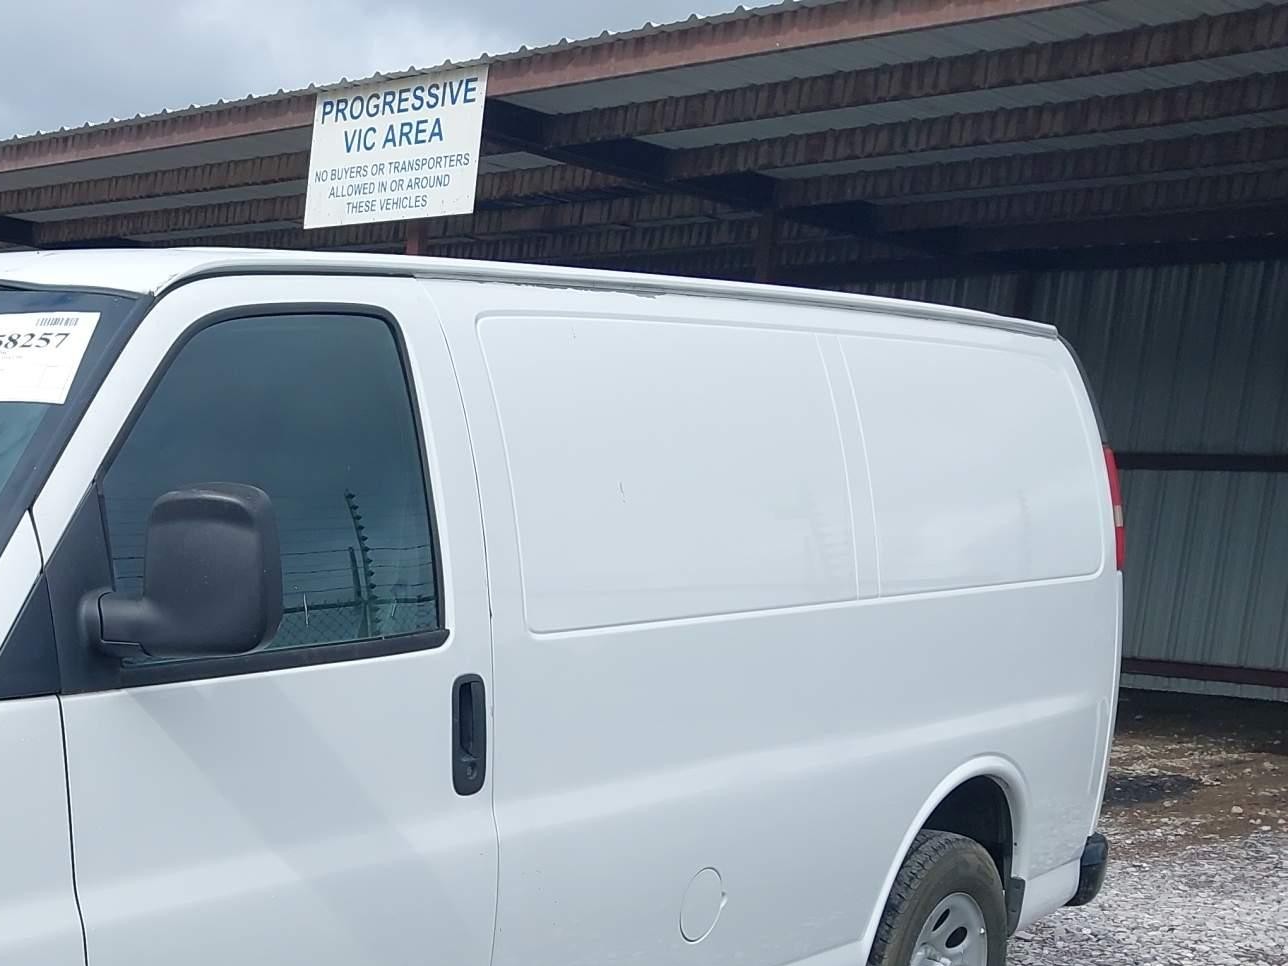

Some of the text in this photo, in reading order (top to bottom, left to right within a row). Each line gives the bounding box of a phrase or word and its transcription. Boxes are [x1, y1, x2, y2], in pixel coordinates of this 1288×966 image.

[321, 77, 479, 125] PROGRESSIVE
[344, 117, 444, 154] VIC AREA
[314, 152, 470, 183] NO BUYERS OR TRANSPORTERS
[328, 173, 450, 199] ALLOWED IN OR AROUND
[346, 194, 428, 214] THESE VEHICLES
